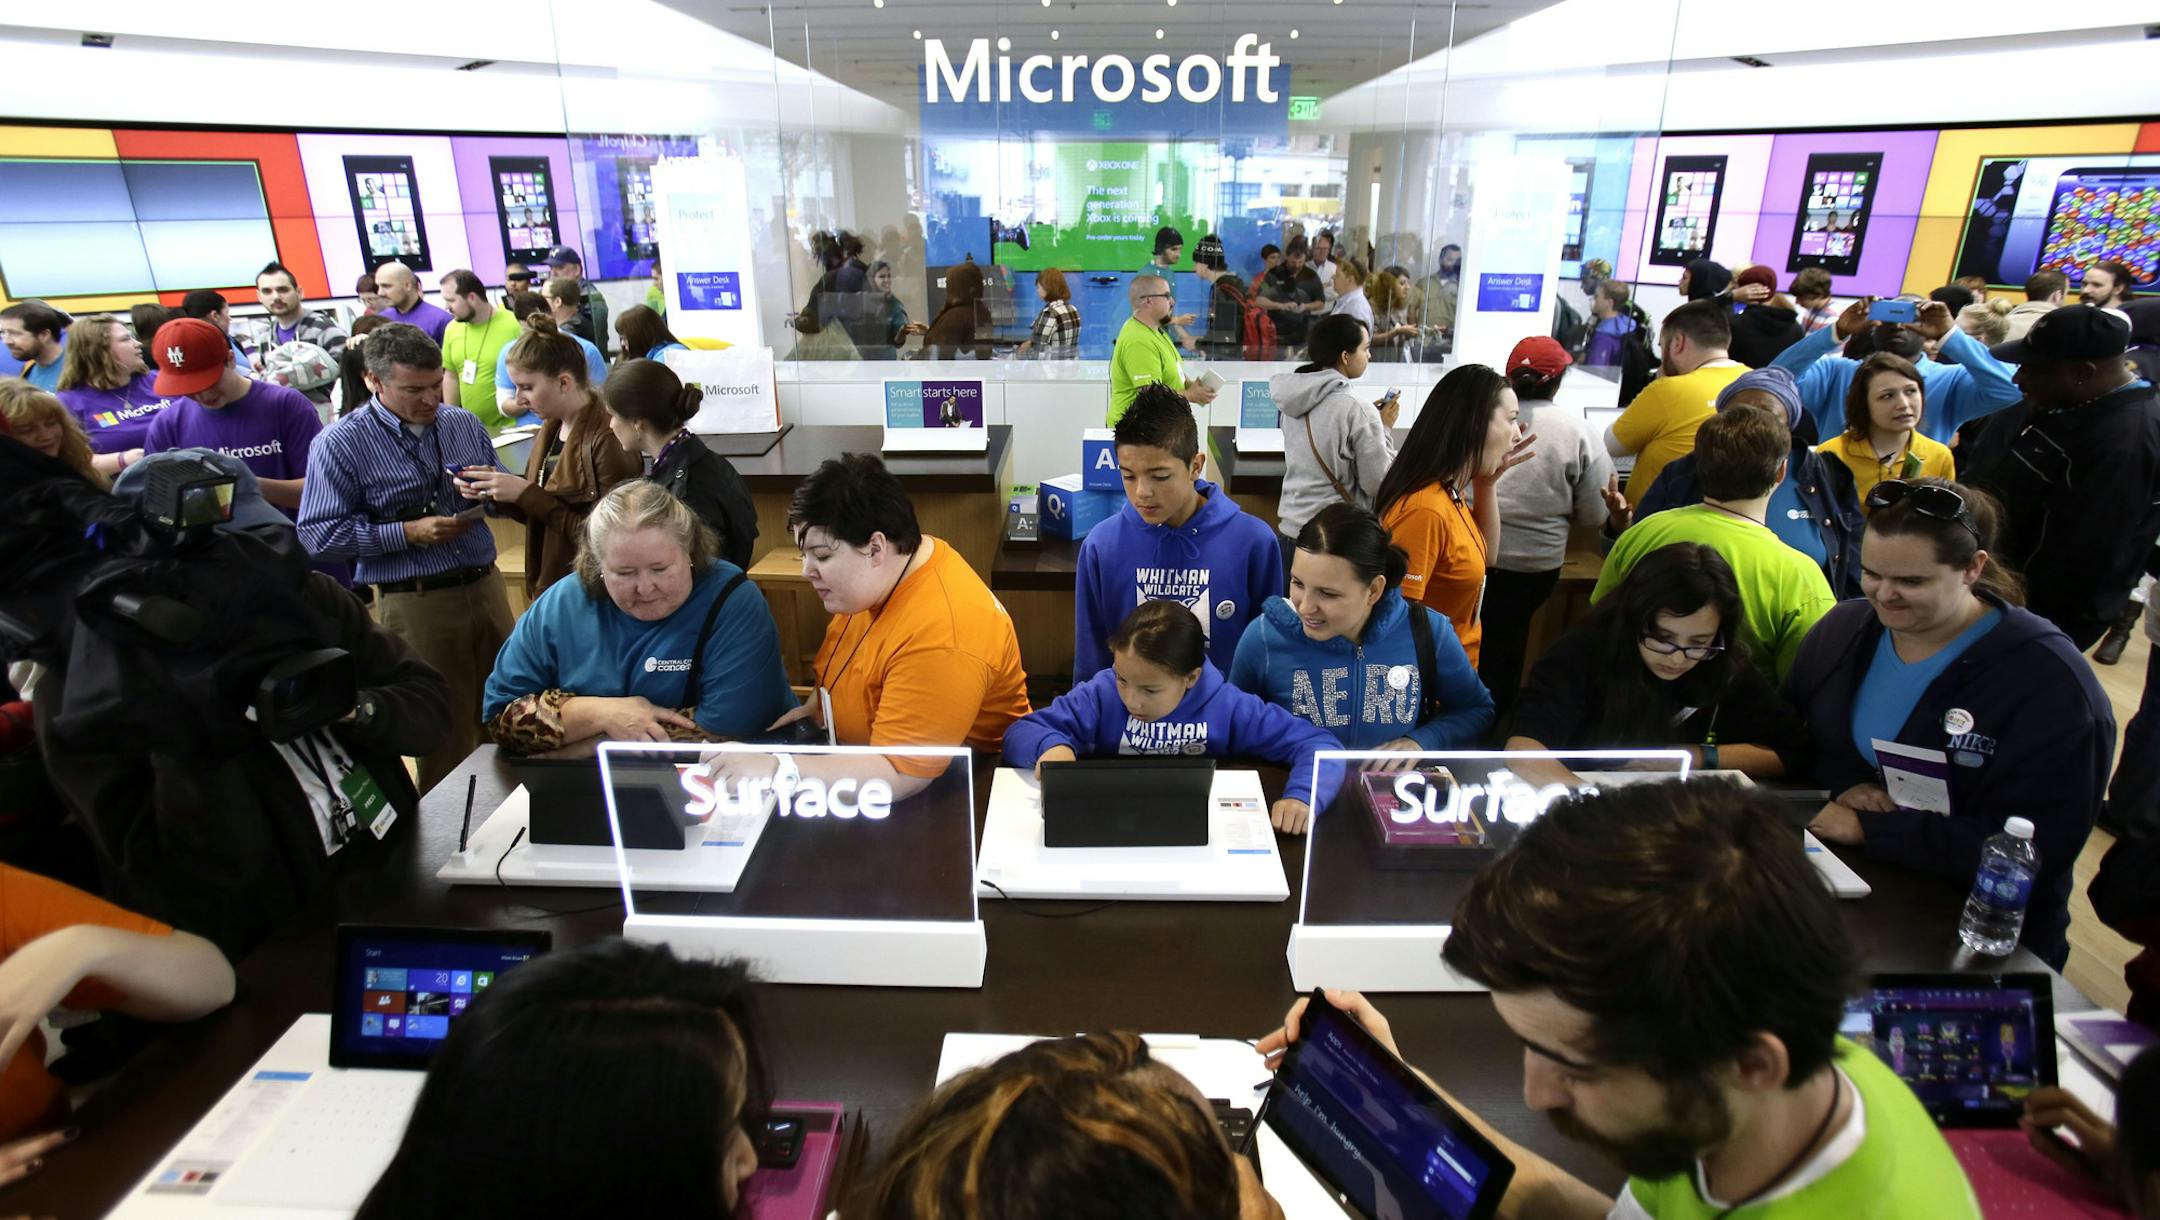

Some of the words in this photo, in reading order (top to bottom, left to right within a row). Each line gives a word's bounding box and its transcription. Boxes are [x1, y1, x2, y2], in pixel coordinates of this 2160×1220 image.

[923, 32, 1281, 104] Microsoft
[1087, 186, 1105, 195] The
[1107, 186, 1128, 195] next
[1087, 199, 1139, 211] generation
[678, 208, 714, 220] Protect
[1086, 213, 1111, 223] Xbox
[1113, 213, 1121, 223] is
[1122, 214, 1159, 226] coming
[686, 275, 711, 285] Answer
[713, 275, 730, 284] Desk
[1487, 277, 1513, 285] Answer
[1515, 277, 1532, 286] Desk
[704, 383, 760, 397] Microsoft
[889, 386, 922, 398] Smart
[923, 387, 951, 398] starts
[952, 385, 977, 398] here
[1247, 386, 1270, 399] Sma
[116, 398, 172, 421] Microsoft
[211, 438, 283, 459] Microsoft
[1094, 447, 1120, 470] A
[1047, 493, 1066, 520] Q:
[1017, 517, 1033, 530] A:
[1136, 568, 1210, 585] WHITMAN
[1404, 573, 1424, 582] rosoft
[1143, 584, 1201, 596] WILDCATS
[657, 664, 692, 672] concer
[1292, 664, 1420, 728] AERO
[1125, 714, 1208, 740] WHITMAN
[1946, 732, 1997, 756] NIKE
[679, 761, 893, 820] Surface
[1390, 767, 1601, 826] Surfac
[365, 948, 383, 957] Start
[435, 972, 449, 984] 20
[1294, 1084, 1312, 1107] help
